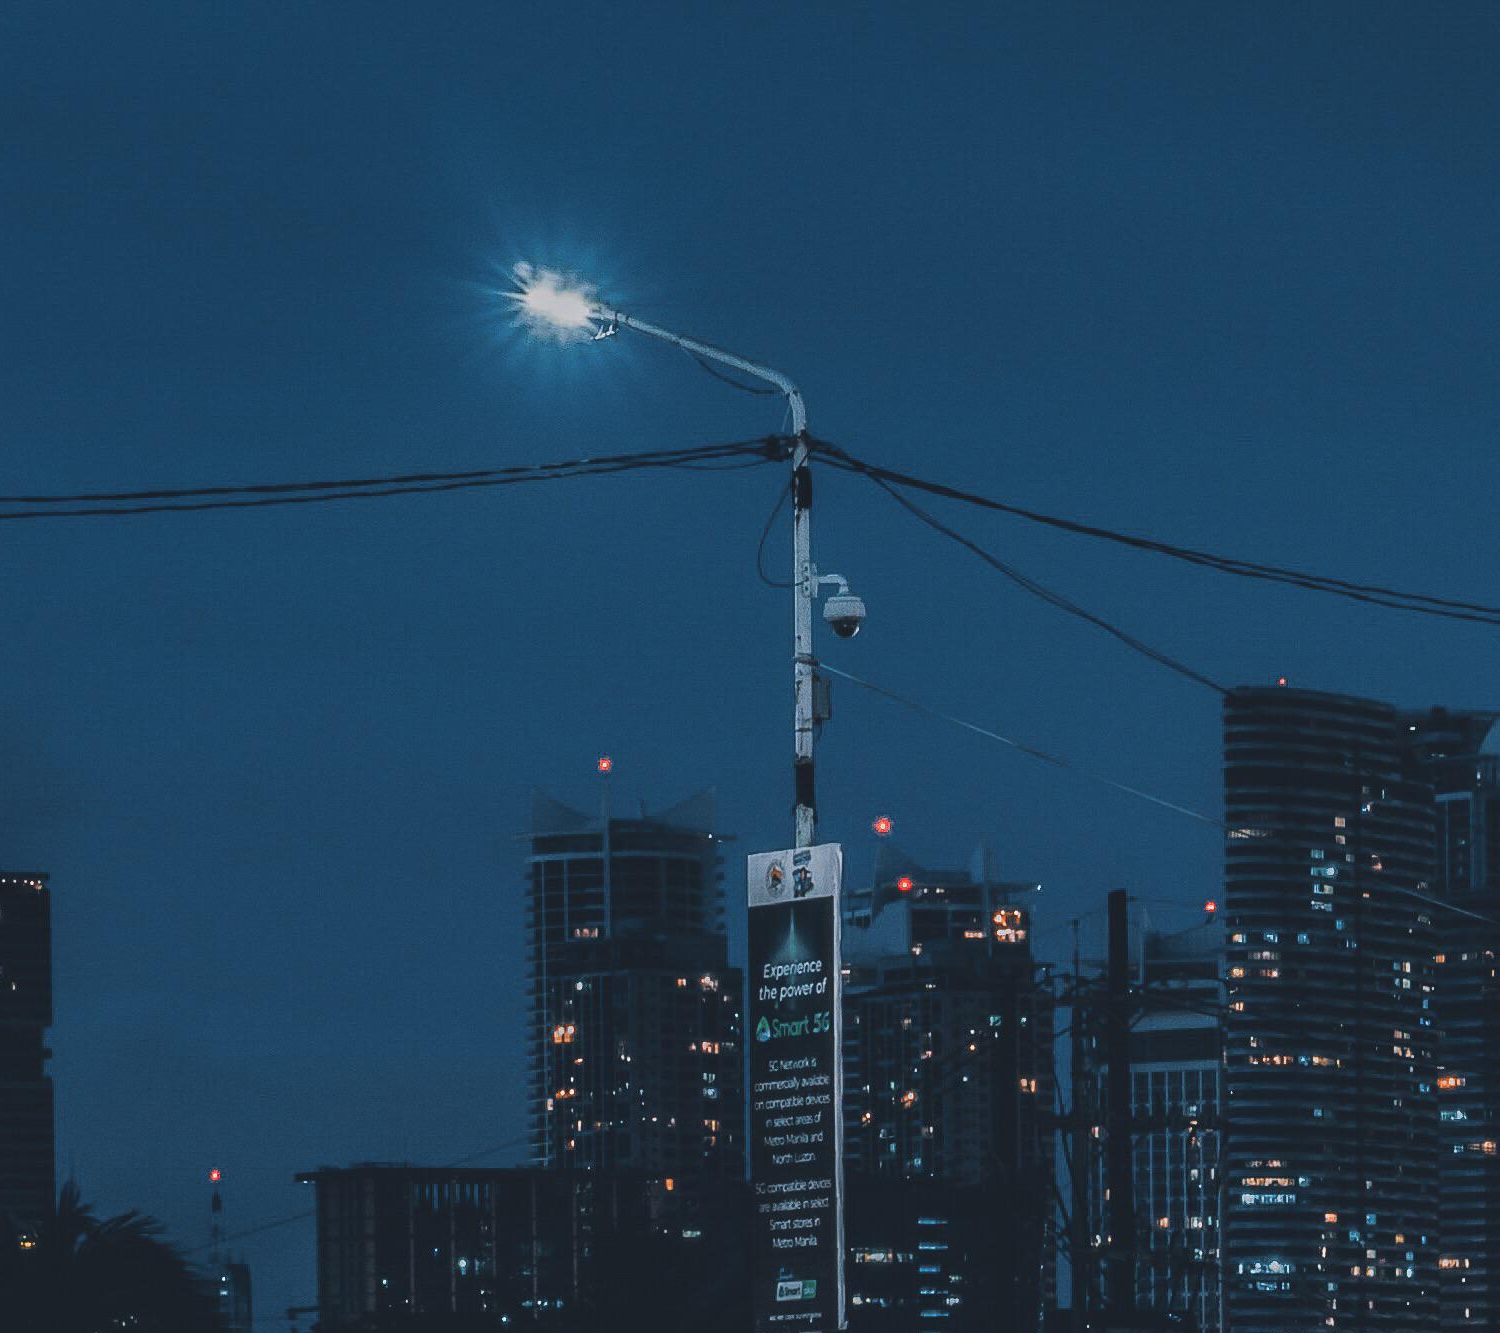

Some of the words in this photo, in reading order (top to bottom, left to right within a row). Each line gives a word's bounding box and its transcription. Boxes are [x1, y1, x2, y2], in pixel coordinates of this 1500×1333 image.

[763, 960, 822, 980] Experience
[759, 985, 777, 1000] the
[780, 983, 814, 1001] power
[816, 977, 827, 994] of
[772, 1016, 810, 1038] Smart
[813, 1011, 830, 1033] 5G
